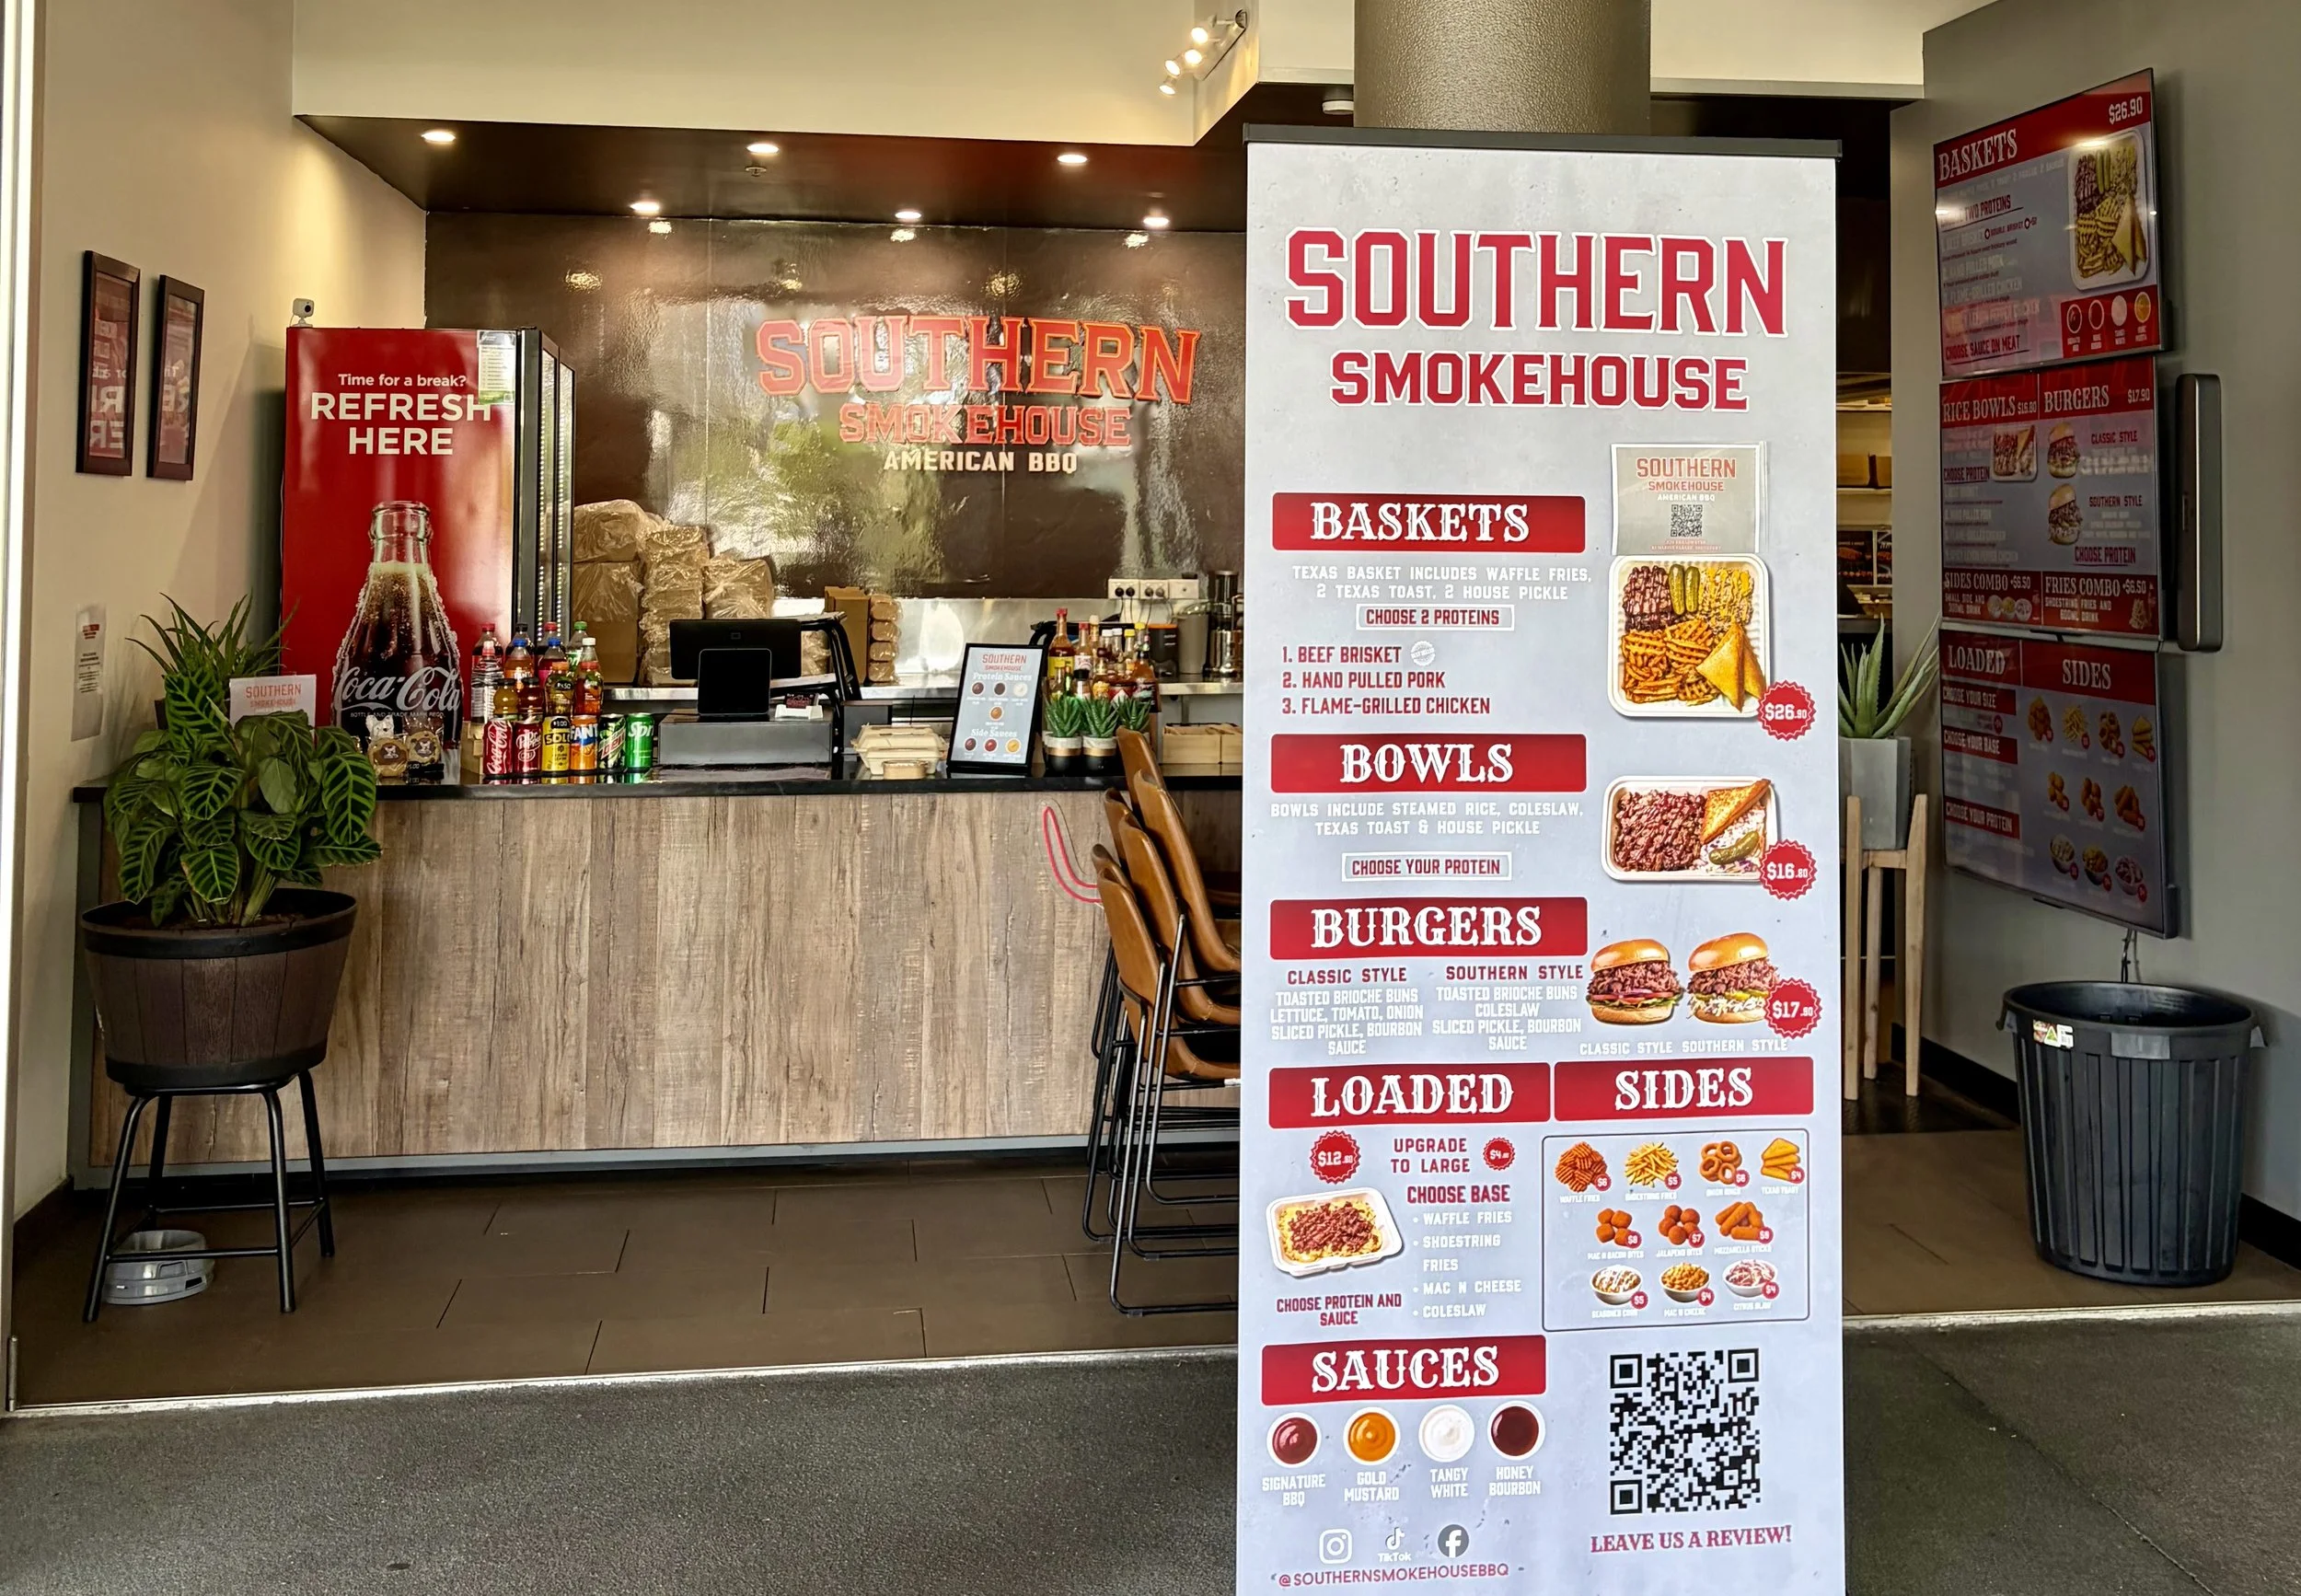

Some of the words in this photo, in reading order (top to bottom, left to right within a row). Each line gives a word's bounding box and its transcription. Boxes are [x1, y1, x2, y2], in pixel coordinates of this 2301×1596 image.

[2109, 97, 2143, 124] $26.90
[1939, 128, 2018, 181] BASKETS
[1981, 195, 2011, 216] PROTEINS
[1284, 226, 1788, 339] SOUTHERN
[1946, 344, 1968, 360] CHOOSE
[1971, 340, 1989, 355] SAUCE
[1992, 339, 2000, 353] ON
[2002, 335, 2020, 350] MEAT
[755, 314, 1200, 405] SOUTHERN
[339, 374, 375, 387] Time
[378, 374, 399, 387] for
[403, 376, 412, 387] a
[416, 374, 467, 387] break?
[1330, 352, 1750, 413] SMOKEHOUSE
[311, 392, 492, 422] REFRESH
[2044, 386, 2110, 412] BURGERS
[2128, 387, 2150, 403] $17.90
[1943, 401, 1970, 422] RICE
[1972, 396, 2016, 420] BOWLS
[838, 402, 1132, 445] SMOKEHOUSE
[349, 427, 453, 455] HERE
[2091, 433, 2116, 444] CLASSIC
[2120, 431, 2137, 443] STYLE
[884, 451, 1014, 471] AMERICAN
[1028, 452, 1077, 474] BBQ
[1636, 457, 1737, 479] SOUTHERN
[1648, 480, 1724, 492] SMOKEHOUSE
[1658, 493, 1697, 502] AMERICAN
[1700, 493, 1716, 502] BBQ
[2089, 496, 2121, 507] SOUTHERN
[2124, 495, 2143, 506] STYLE
[1310, 503, 1530, 542] BASKETS
[2075, 547, 2102, 562] CHOOSE
[2105, 547, 2135, 563] PROTEIN
[1292, 565, 1337, 580] TEXAS
[1347, 567, 1401, 580] BASKET
[1410, 567, 1476, 581] INCLUDES
[1486, 567, 1539, 581] WAFFLE
[1548, 568, 1591, 582] FRIES,
[1945, 572, 1971, 589] SIDES
[1973, 573, 2008, 591] COMBO
[1316, 584, 1326, 597] 2
[1336, 584, 1379, 598] TEXAS
[1389, 585, 1437, 599] TOAST,
[1445, 585, 1453, 598] 2
[1463, 586, 1509, 599] HOUSE
[1520, 587, 1567, 599] PICKLE
[2045, 576, 2076, 594] FRIES
[2079, 577, 2120, 596] COMBO
[2099, 599, 2111, 610] AND
[1366, 609, 1416, 624] CHOOSE
[1421, 609, 1428, 624] 2
[1434, 609, 1499, 625] PROTEINS
[982, 654, 1026, 664] SOUTHERN
[1282, 646, 1292, 663] 1.
[1298, 646, 1336, 663] BEEF
[1340, 647, 1402, 663] BRISKET
[1948, 645, 2006, 675] LOADED
[973, 672, 1003, 680] Protein
[1282, 672, 1297, 688] 2.
[1302, 672, 1343, 688] HAND
[1347, 672, 1403, 688] PULLED
[1407, 673, 1446, 688] PORK
[2063, 658, 2111, 689] SIDES
[246, 685, 301, 698] SOUTHERN
[337, 665, 462, 712] Coca-Cola
[1282, 698, 1296, 714] 3.
[1301, 698, 1421, 714] FLAME-GRILLED
[1426, 698, 1490, 714] CHICKEN
[1983, 692, 1996, 708] SIZE
[1764, 703, 1807, 721] $26.90
[487, 720, 507, 774] Coca-Cola
[1944, 730, 1966, 747] CHOOSE
[1983, 736, 2000, 754] BASE
[1340, 744, 1513, 782] BOWLS
[1270, 804, 1318, 817] BOWLS
[1327, 803, 1384, 817] INCLUDE
[1392, 802, 1456, 816] STEAMED
[1465, 802, 1500, 817] RICE,
[1509, 802, 1583, 817] COLESLAW,
[1315, 822, 1359, 836] TEXAS
[1368, 821, 1410, 836] TOAST
[1418, 821, 1428, 834] &
[1438, 821, 1483, 834] HOUSE
[1492, 821, 1539, 835] PICKLE
[1352, 860, 1401, 875] CHOOSE
[1405, 860, 1440, 874] YOUR
[1444, 860, 1500, 874] PROTEIN
[1311, 906, 1542, 948] BURGERS
[1288, 969, 1351, 985] CLASSIC
[1362, 967, 1406, 982] STYLE
[1446, 966, 1528, 980] SOUTHERN
[1539, 966, 1583, 979] STYLE
[1276, 991, 1330, 1005] TOASTED
[1334, 989, 1382, 1004] BRIOCHE
[1386, 989, 1418, 1002] BUNS
[1436, 987, 1490, 1001] TOASTED
[1494, 987, 1543, 1000] BRIOCHE
[1546, 986, 1577, 1000] BUNS
[1270, 1008, 1328, 1024] LETTUCE,
[1333, 1006, 1382, 1022] TOMATO,
[1387, 1005, 1424, 1020] ONION
[1474, 1003, 1539, 1017] COLESLAW
[1271, 1025, 1314, 1040] SLICED
[1317, 1024, 1363, 1039] PICKLE,
[1368, 1023, 1422, 1037] BOURBON
[1432, 1020, 1474, 1035] SLICED
[1478, 1020, 1523, 1035] PICKLE,
[1528, 1018, 1580, 1033] BOURBON
[1328, 1040, 1366, 1055] SAUCE
[1488, 1036, 1527, 1051] SAUCE
[1579, 1042, 1630, 1056] CLASSIC
[1637, 1042, 1672, 1054] STYLE
[1682, 1039, 1744, 1053] SOUTHERN
[1752, 1039, 1787, 1052] STYLE
[1311, 1073, 1514, 1117] LOADED
[1614, 1067, 1753, 1111] SIDES
[1393, 1138, 1467, 1152] UPGRADE
[1391, 1159, 1410, 1174] TO
[1421, 1158, 1470, 1173] LARGE
[1406, 1186, 1466, 1204] CHOOSE
[1471, 1185, 1510, 1202] BASE
[1423, 1212, 1469, 1226] WAFFLE
[1477, 1211, 1512, 1224] FRIES
[1423, 1235, 1500, 1248] SHOESTRING
[1423, 1259, 1458, 1271] FRIES
[1423, 1283, 1451, 1295] MAC
[1474, 1280, 1521, 1293] CHEESE
[1277, 1298, 1322, 1313] CHOOSE
[1324, 1296, 1373, 1310] PROTEIN
[1377, 1294, 1402, 1308] AND
[1423, 1304, 1486, 1318] COLESLAW
[1320, 1312, 1358, 1326] SAUCE
[1312, 1346, 1499, 1394] SAUCES
[1357, 1472, 1386, 1486] GOLD
[1430, 1467, 1468, 1483] TANGY
[1496, 1465, 1533, 1480] HONEY
[1262, 1475, 1325, 1491] SIGNATURE
[1430, 1484, 1468, 1498] WHITE
[1488, 1481, 1541, 1497] BOURBON
[1282, 1491, 1304, 1508] BBQ
[1344, 1486, 1399, 1501] MUSTARD
[1590, 1532, 1654, 1553] LEAVE
[1659, 1532, 1683, 1549] US
[1688, 1532, 1701, 1548] A
[1706, 1525, 1792, 1546] REVIEW!
[1278, 1563, 1509, 1587] @SOUTHERNSMOKEHOUSEBBQ
